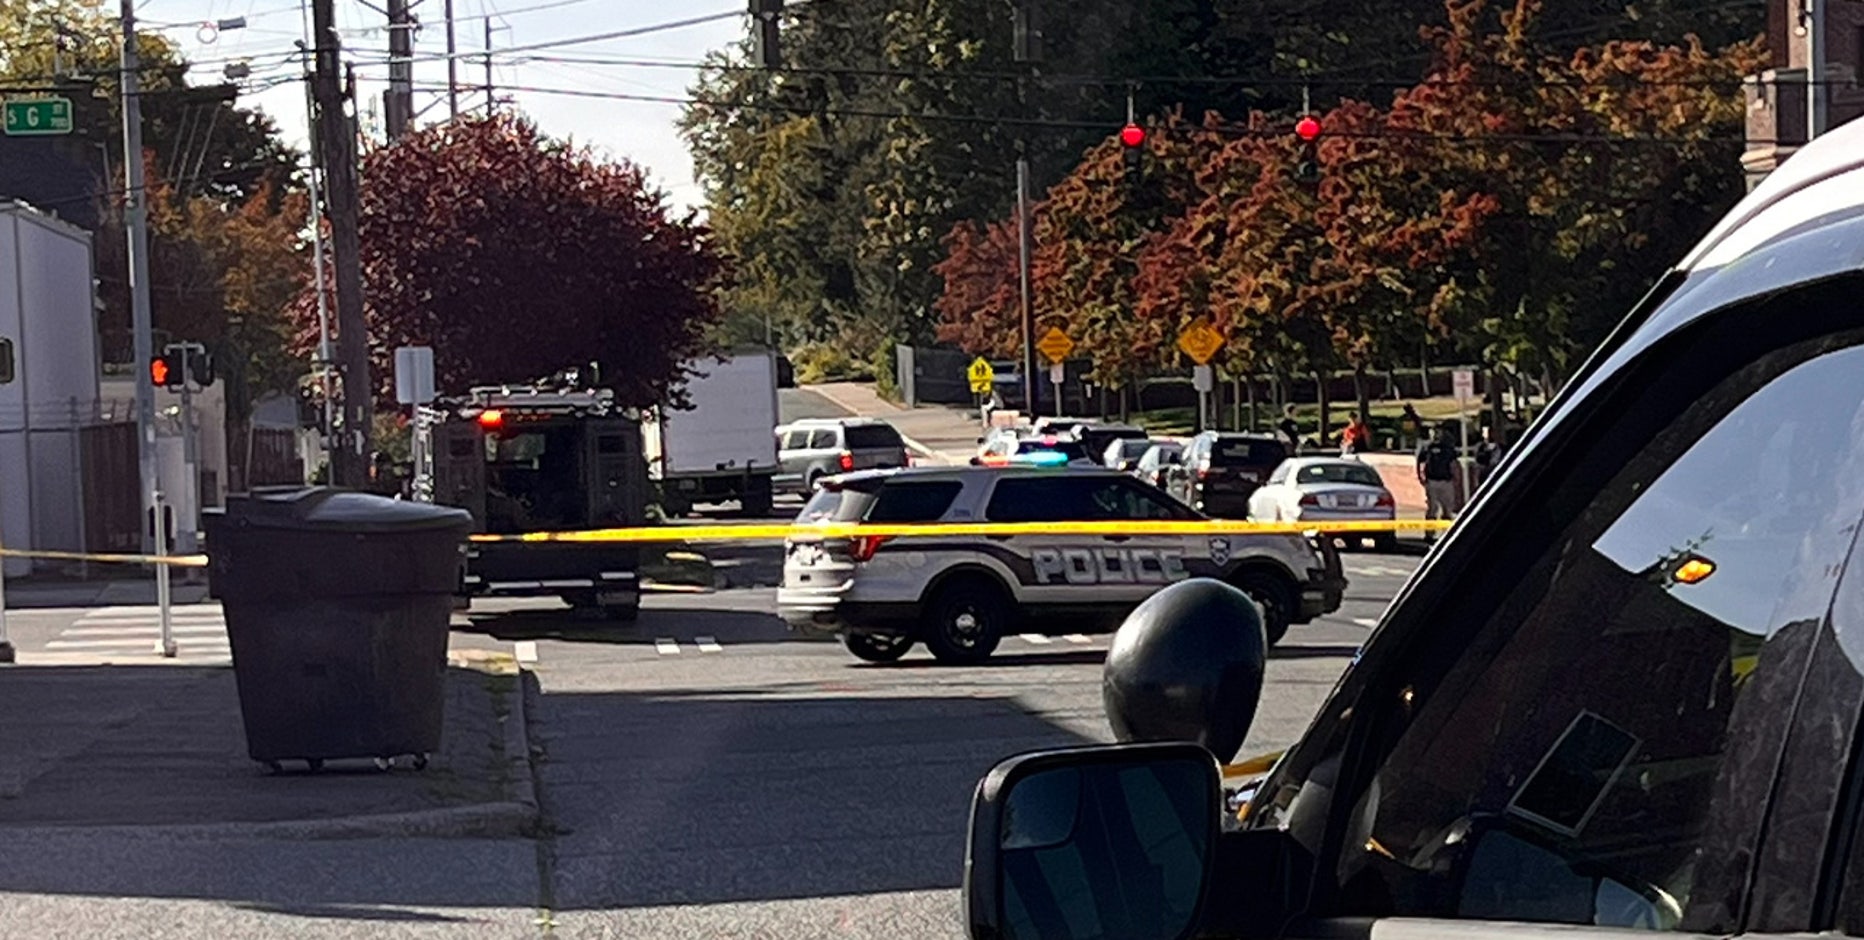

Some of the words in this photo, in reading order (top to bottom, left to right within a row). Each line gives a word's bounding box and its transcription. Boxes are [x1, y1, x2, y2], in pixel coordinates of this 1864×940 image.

[9, 108, 17, 125] S
[27, 106, 39, 127] G
[1031, 548, 1190, 584] POLICE
